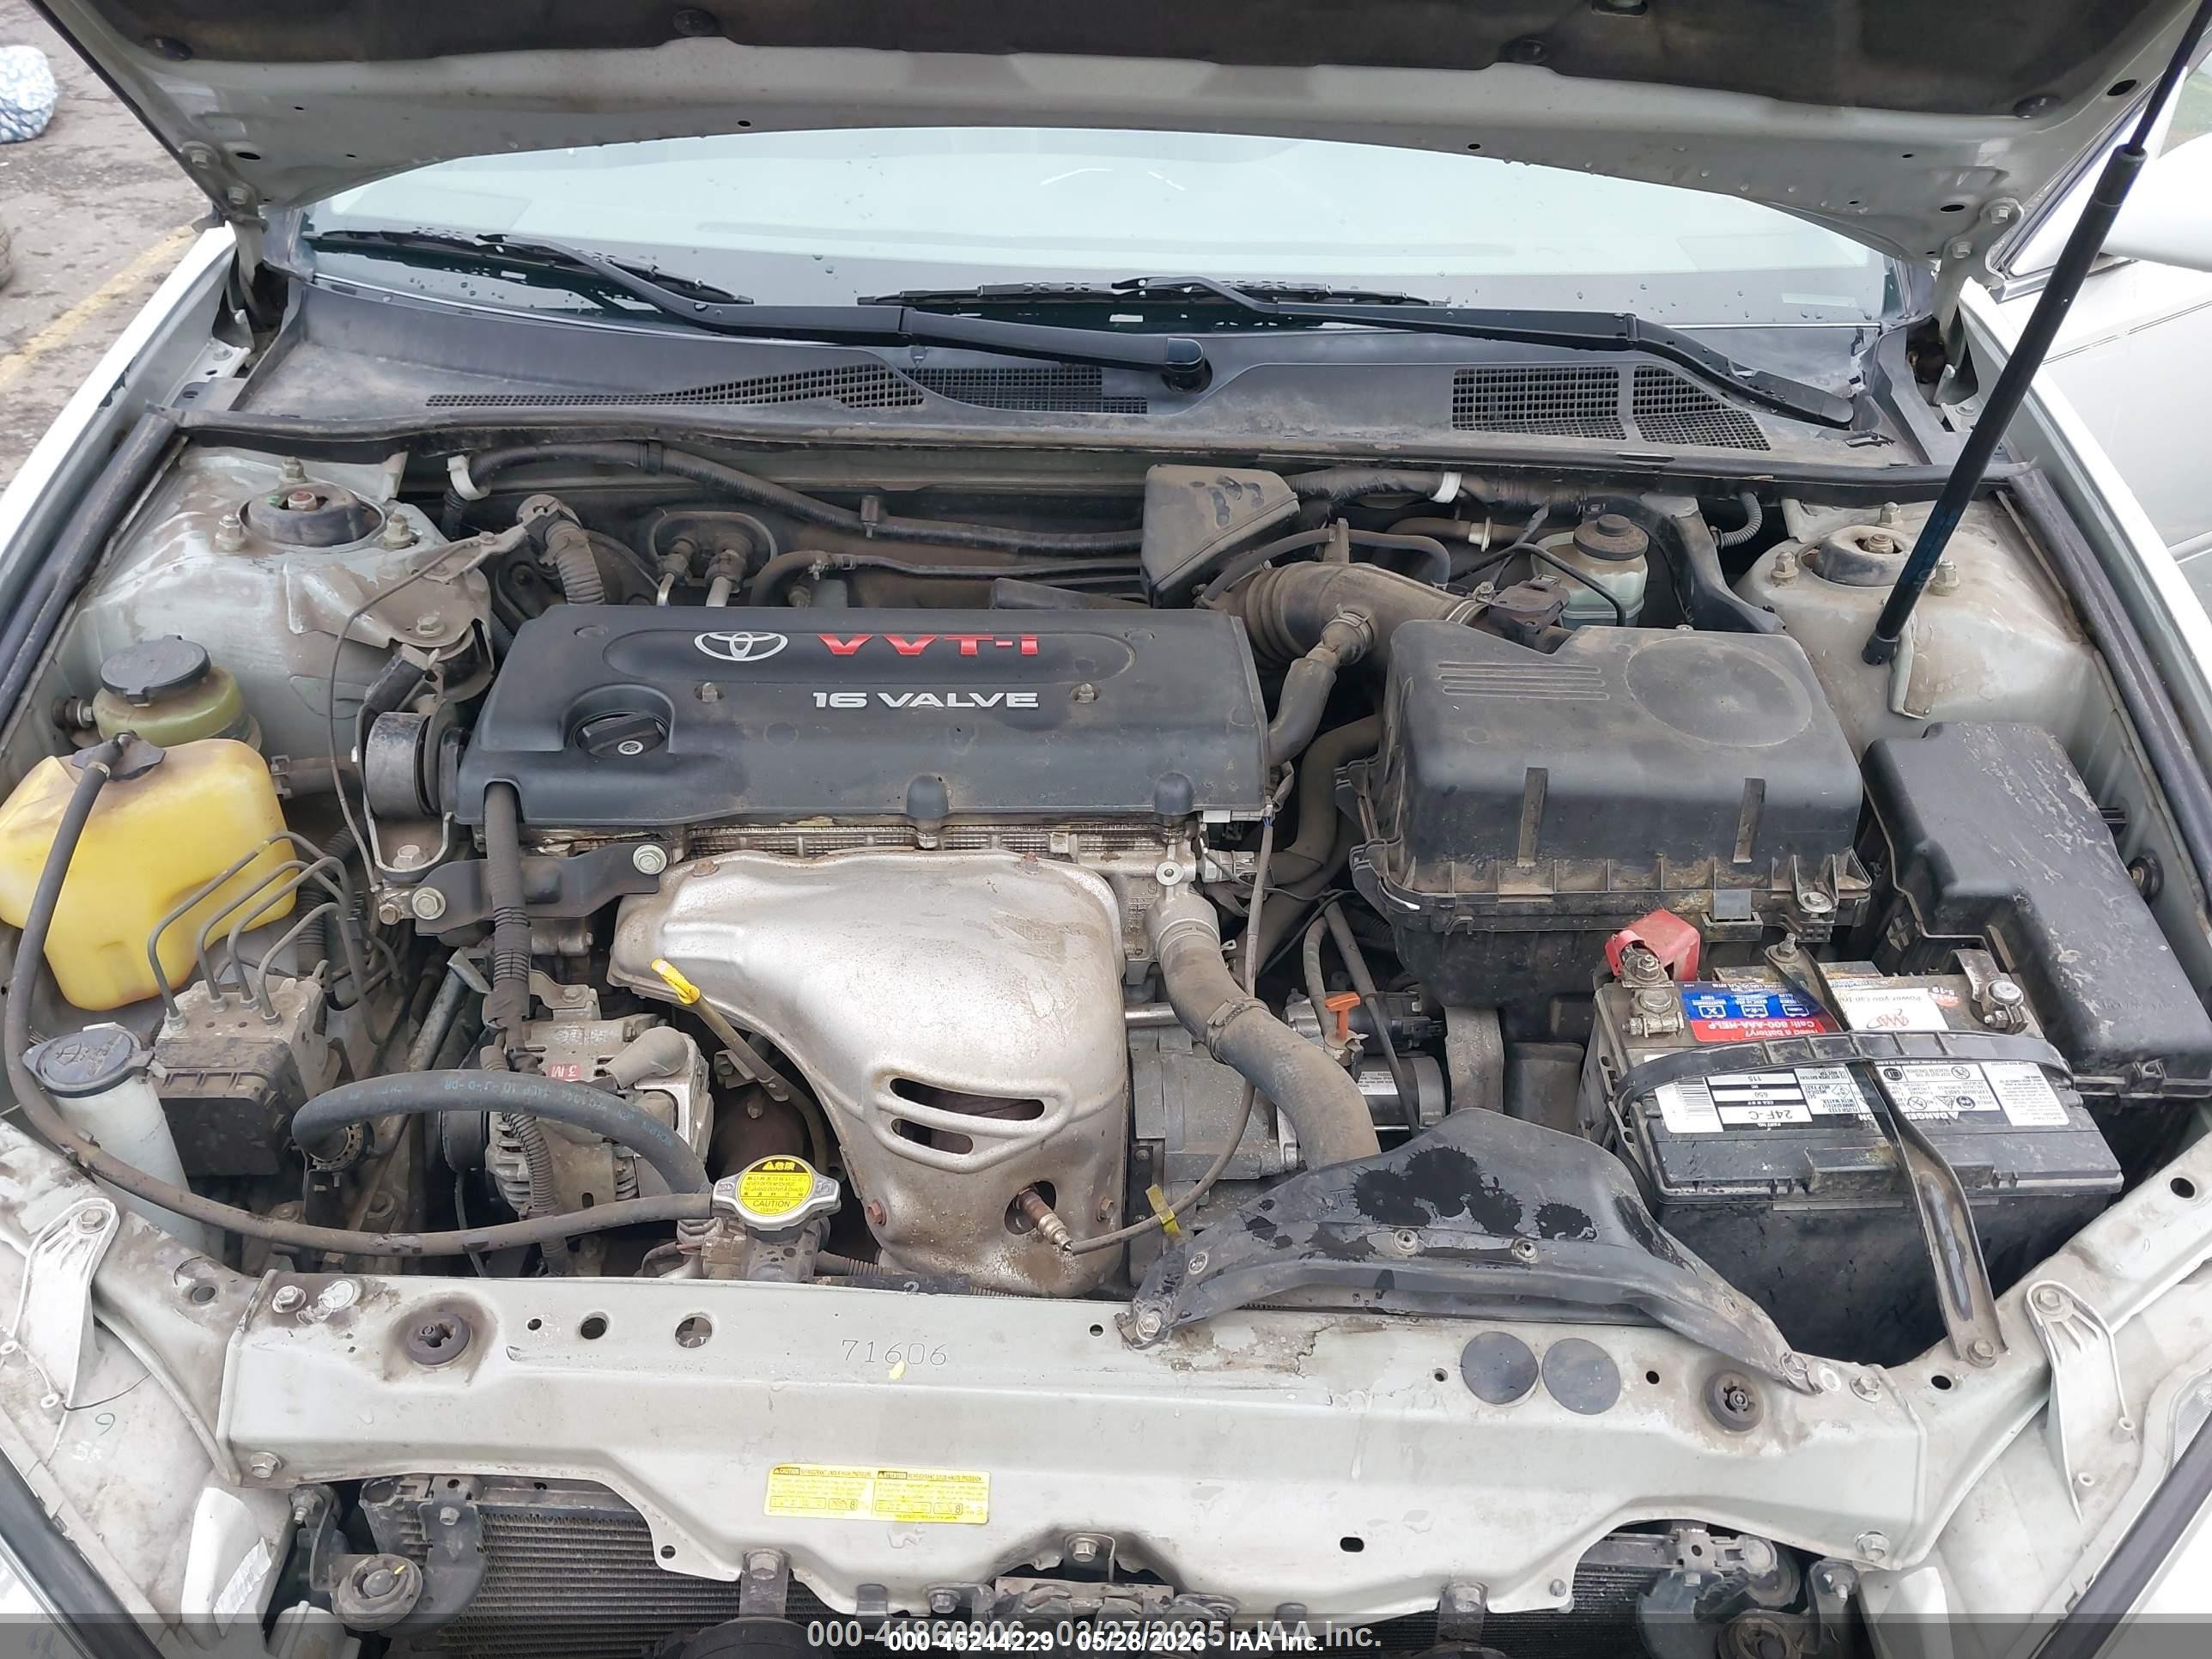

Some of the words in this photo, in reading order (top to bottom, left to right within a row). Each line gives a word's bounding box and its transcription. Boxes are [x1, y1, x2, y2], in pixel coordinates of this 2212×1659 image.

[813, 692, 867, 708] 16
[877, 692, 1039, 708] VALVE
[1708, 1021, 1789, 1030] 800-AAA-HELP
[1745, 1029, 1784, 1037] battery?
[1748, 1109, 1793, 1120] 24F-C
[842, 1340, 947, 1366] 71606
